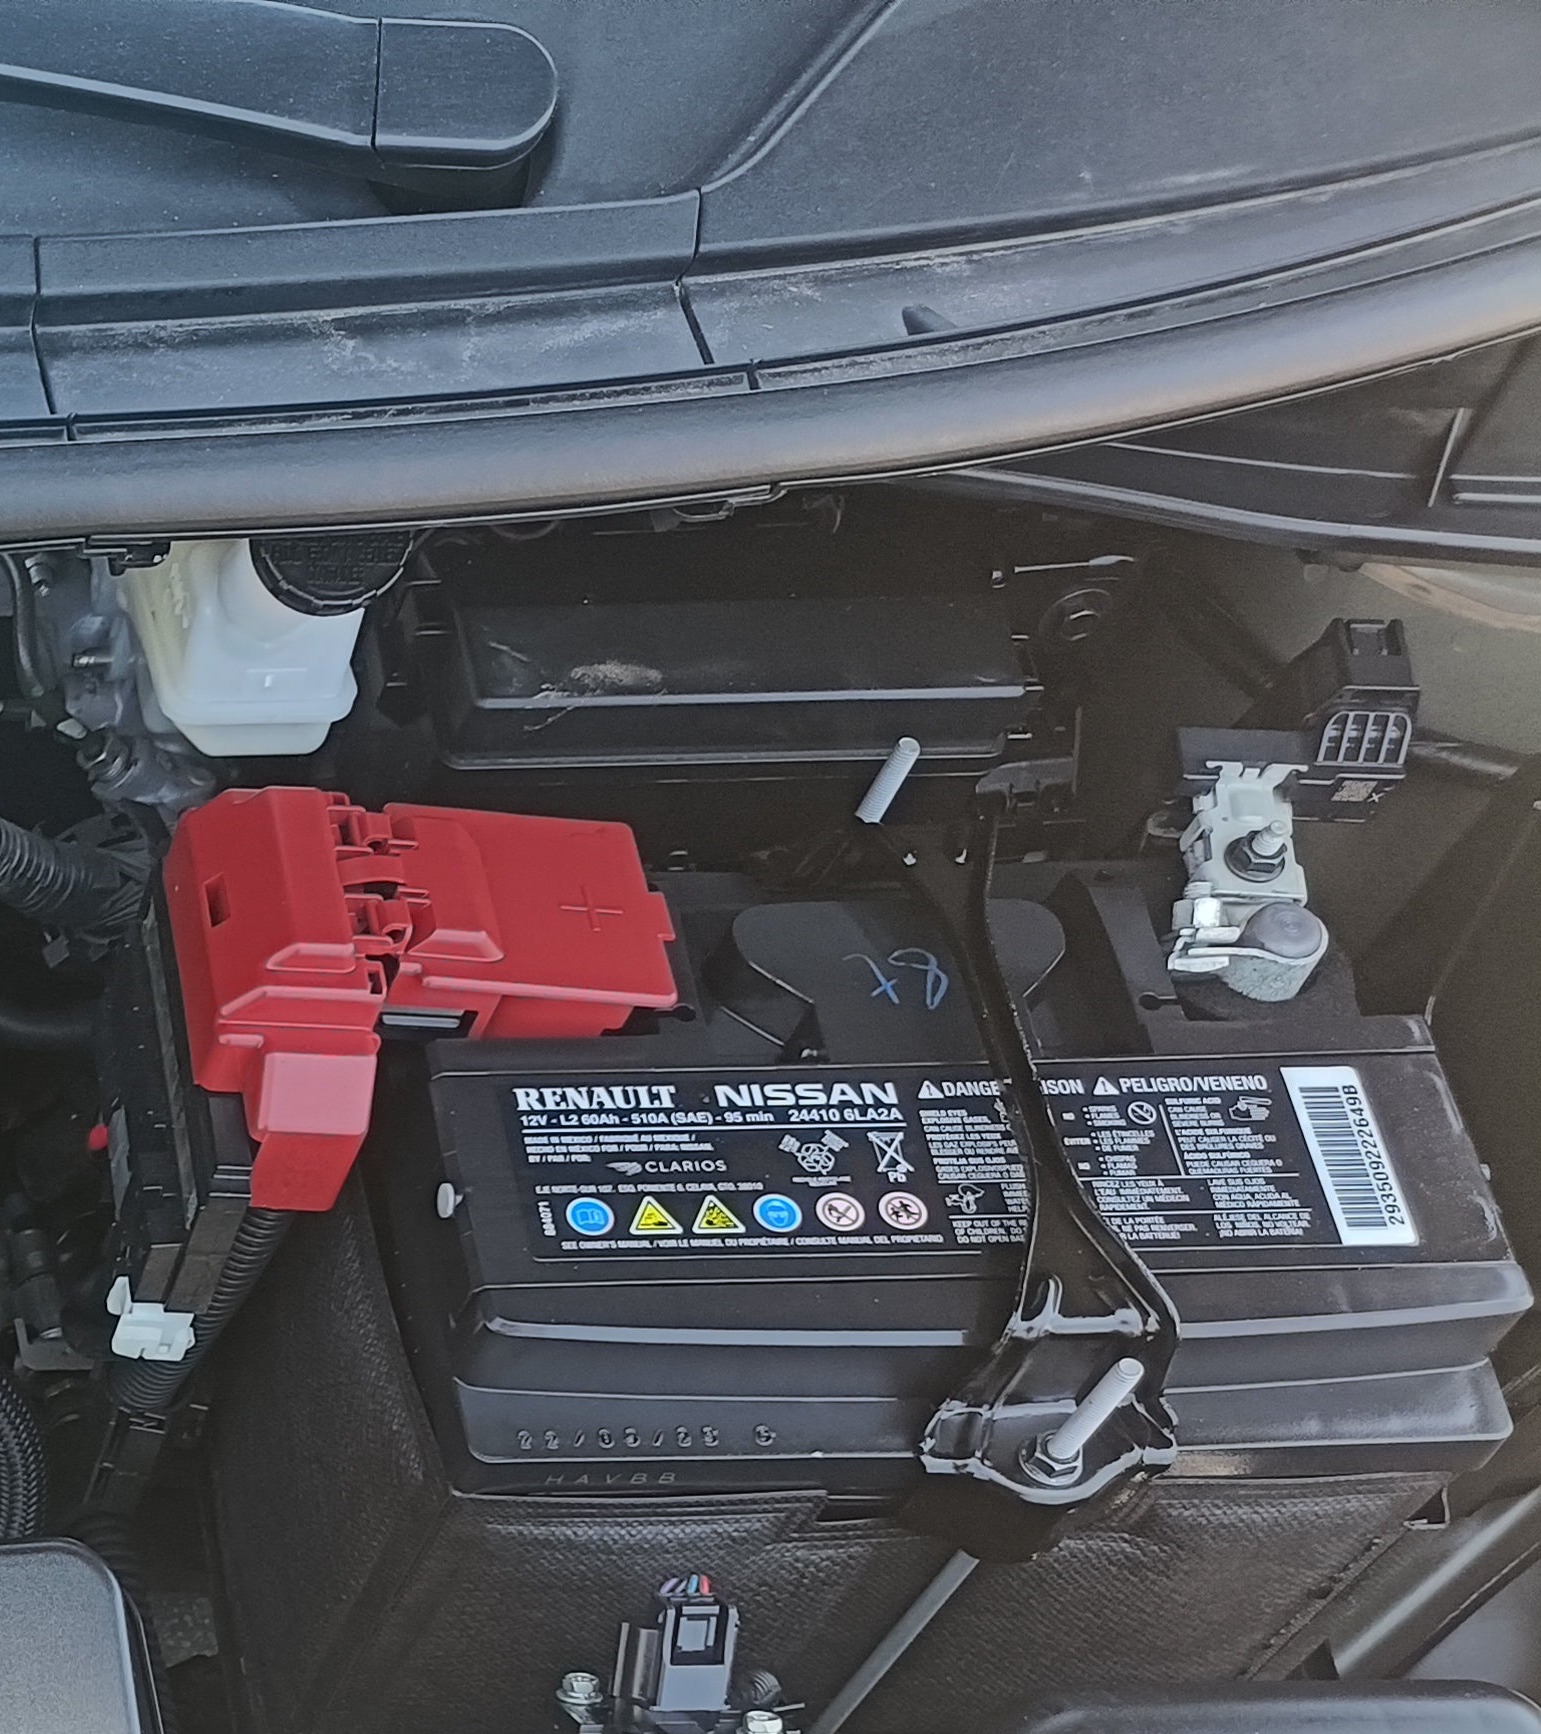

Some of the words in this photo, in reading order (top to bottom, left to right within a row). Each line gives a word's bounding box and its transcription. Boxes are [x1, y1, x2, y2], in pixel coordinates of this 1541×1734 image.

[941, 1081, 1000, 1097] DANGE
[1040, 1079, 1085, 1095] ISON
[1119, 1075, 1267, 1093] PELIGRO/VENENO
[513, 1085, 677, 1111] RENAULT
[714, 1082, 900, 1107] NISSAN
[520, 1115, 549, 1127] 12V
[560, 1114, 579, 1127] L2
[582, 1113, 620, 1126] 60Ah
[631, 1113, 669, 1125] 510A
[671, 1112, 714, 1127] (SAE)
[725, 1111, 744, 1123] 95
[745, 1110, 775, 1122] min
[788, 1108, 840, 1122] 24410
[843, 1107, 904, 1121] 6LA2A
[644, 1159, 727, 1174] CLARIOS
[889, 1171, 907, 1183] Pb
